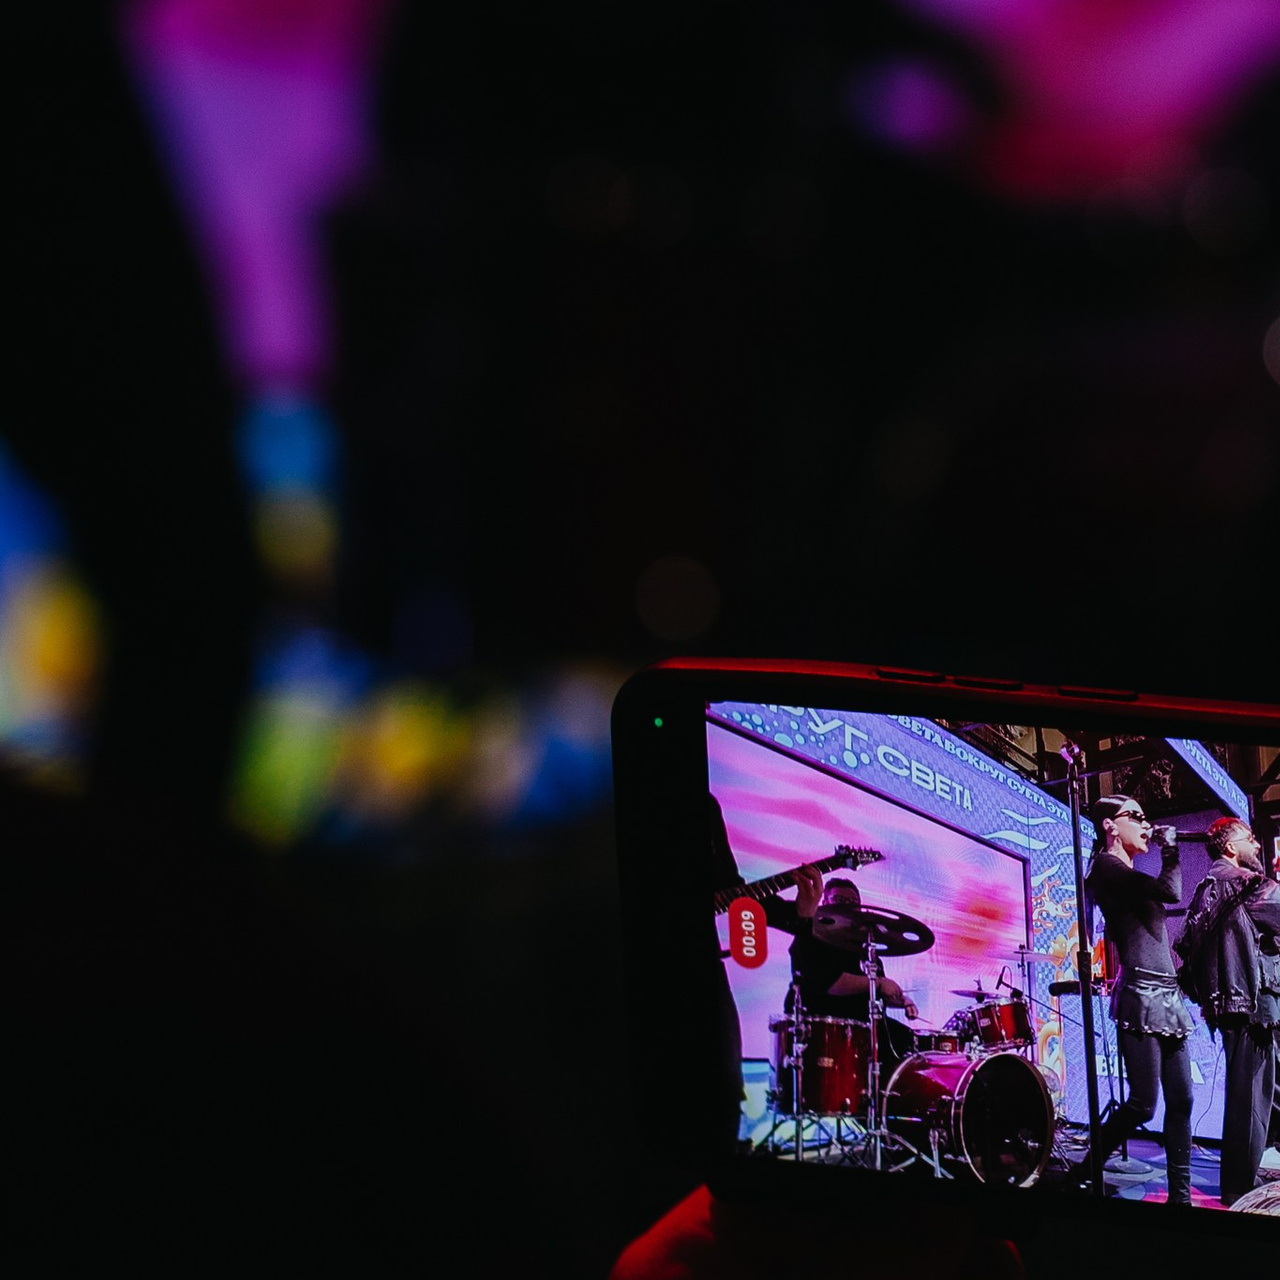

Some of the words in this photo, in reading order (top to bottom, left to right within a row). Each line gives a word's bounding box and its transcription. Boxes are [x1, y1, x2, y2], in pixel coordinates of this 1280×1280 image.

[877, 744, 973, 812] СВЕТА
[887, 714, 944, 748] ВЕТА
[1007, 778, 1046, 809] СУЕТА
[741, 910, 756, 957] 00:09
